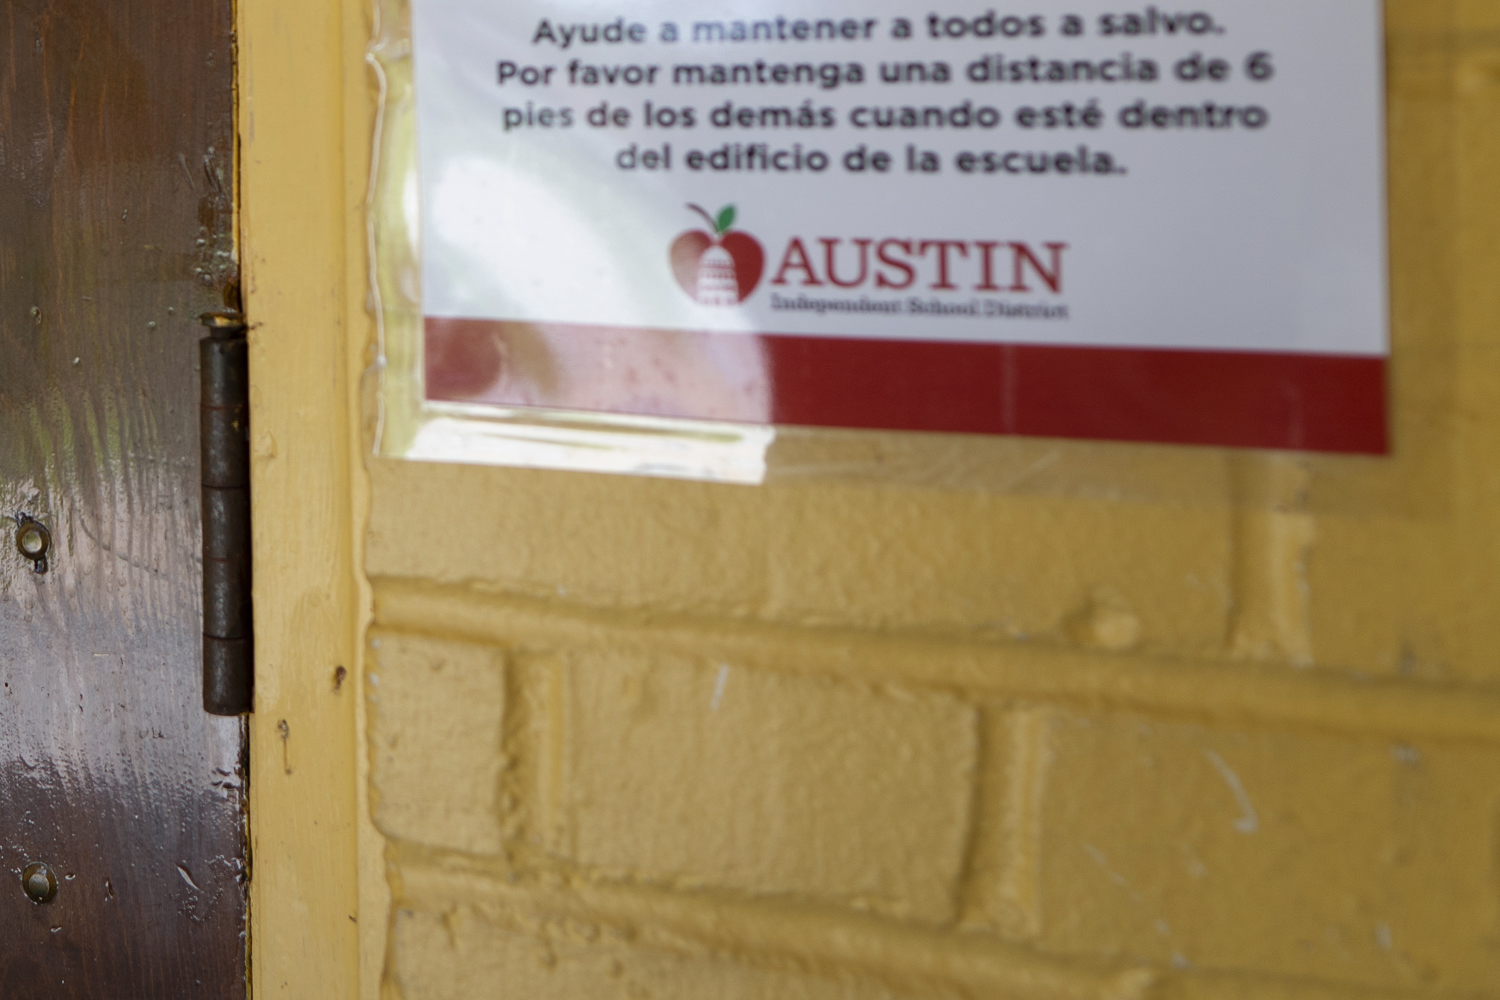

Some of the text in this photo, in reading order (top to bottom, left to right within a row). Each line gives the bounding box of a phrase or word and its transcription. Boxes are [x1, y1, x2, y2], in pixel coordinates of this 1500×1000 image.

[533, 5, 1226, 50] Ayude a mantener a todos a salvo.
[497, 50, 1275, 89] Por favor mantenga una distancia de 6
[503, 97, 1269, 132] pies de los demás cuando esté dentro
[616, 143, 671, 171] del
[686, 143, 829, 172] edificio
[843, 144, 892, 172] de
[906, 144, 940, 173] la
[770, 236, 1069, 293] AUSTIN
[771, 292, 898, 316] Independent
[908, 298, 976, 317] School
